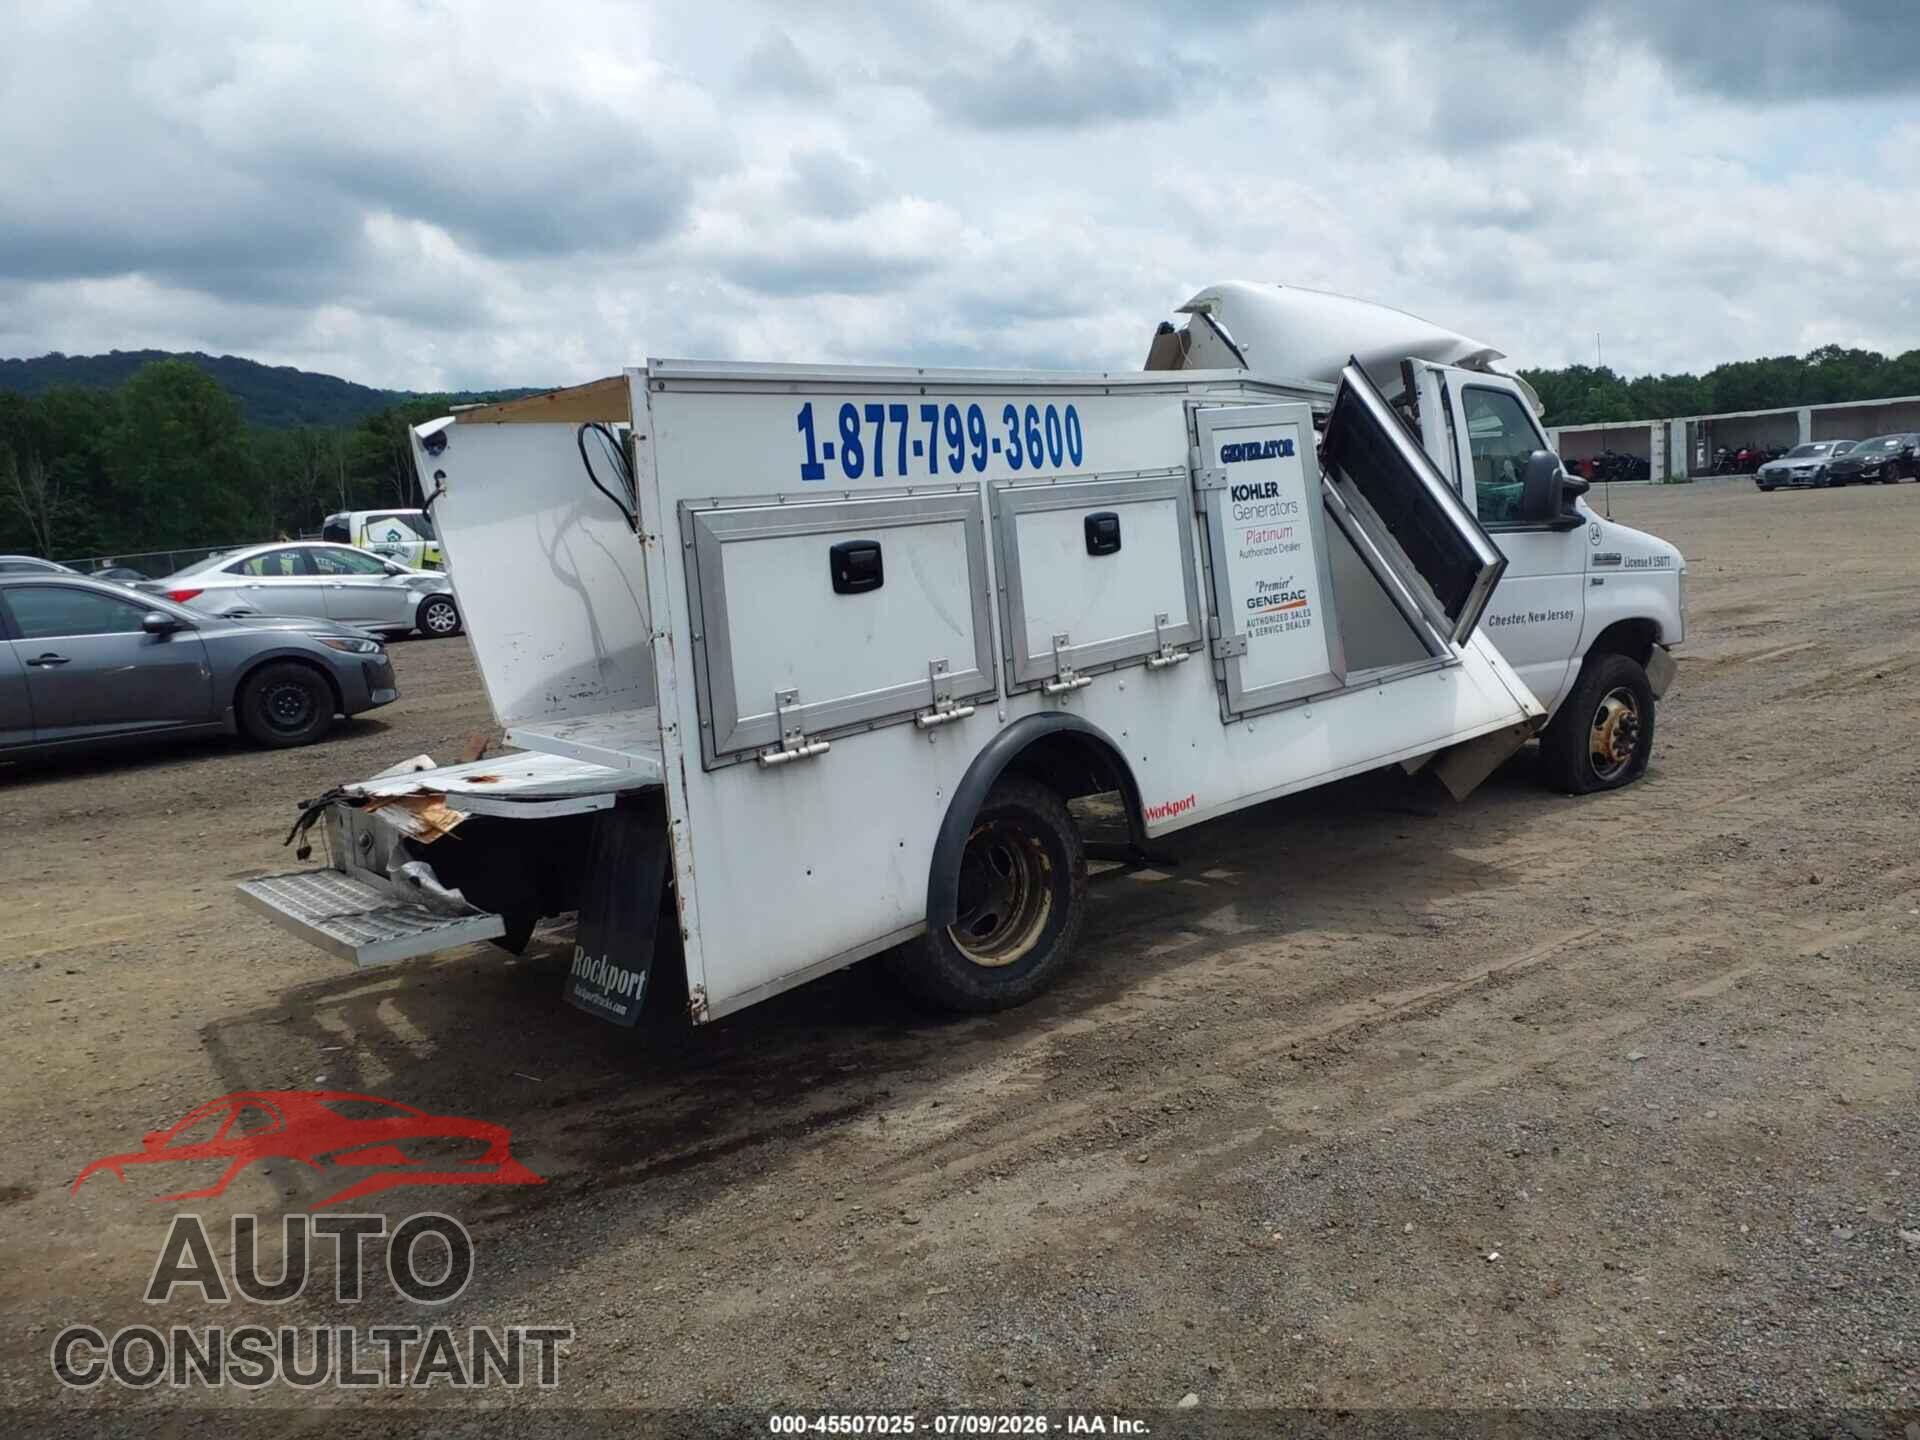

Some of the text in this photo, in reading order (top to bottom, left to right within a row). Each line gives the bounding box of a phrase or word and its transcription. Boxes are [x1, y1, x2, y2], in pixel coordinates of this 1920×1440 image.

[797, 402, 1083, 481] 1-877-799-3600
[1220, 438, 1295, 464] GENERATOR
[1231, 481, 1280, 502] KOHLER
[1232, 500, 1298, 521] Generators
[1246, 526, 1293, 545] Platinum
[1590, 527, 1600, 541] 14
[1239, 541, 1301, 559] Authorized Dealer
[1247, 589, 1307, 609] GENERAC
[1247, 608, 1312, 628] AUTHORIZED SALES
[1255, 623, 1285, 637] SERVICE
[1285, 618, 1311, 631] DEALER
[1489, 609, 1574, 627] Chester, New Jersey
[570, 944, 646, 1001] Rockport
